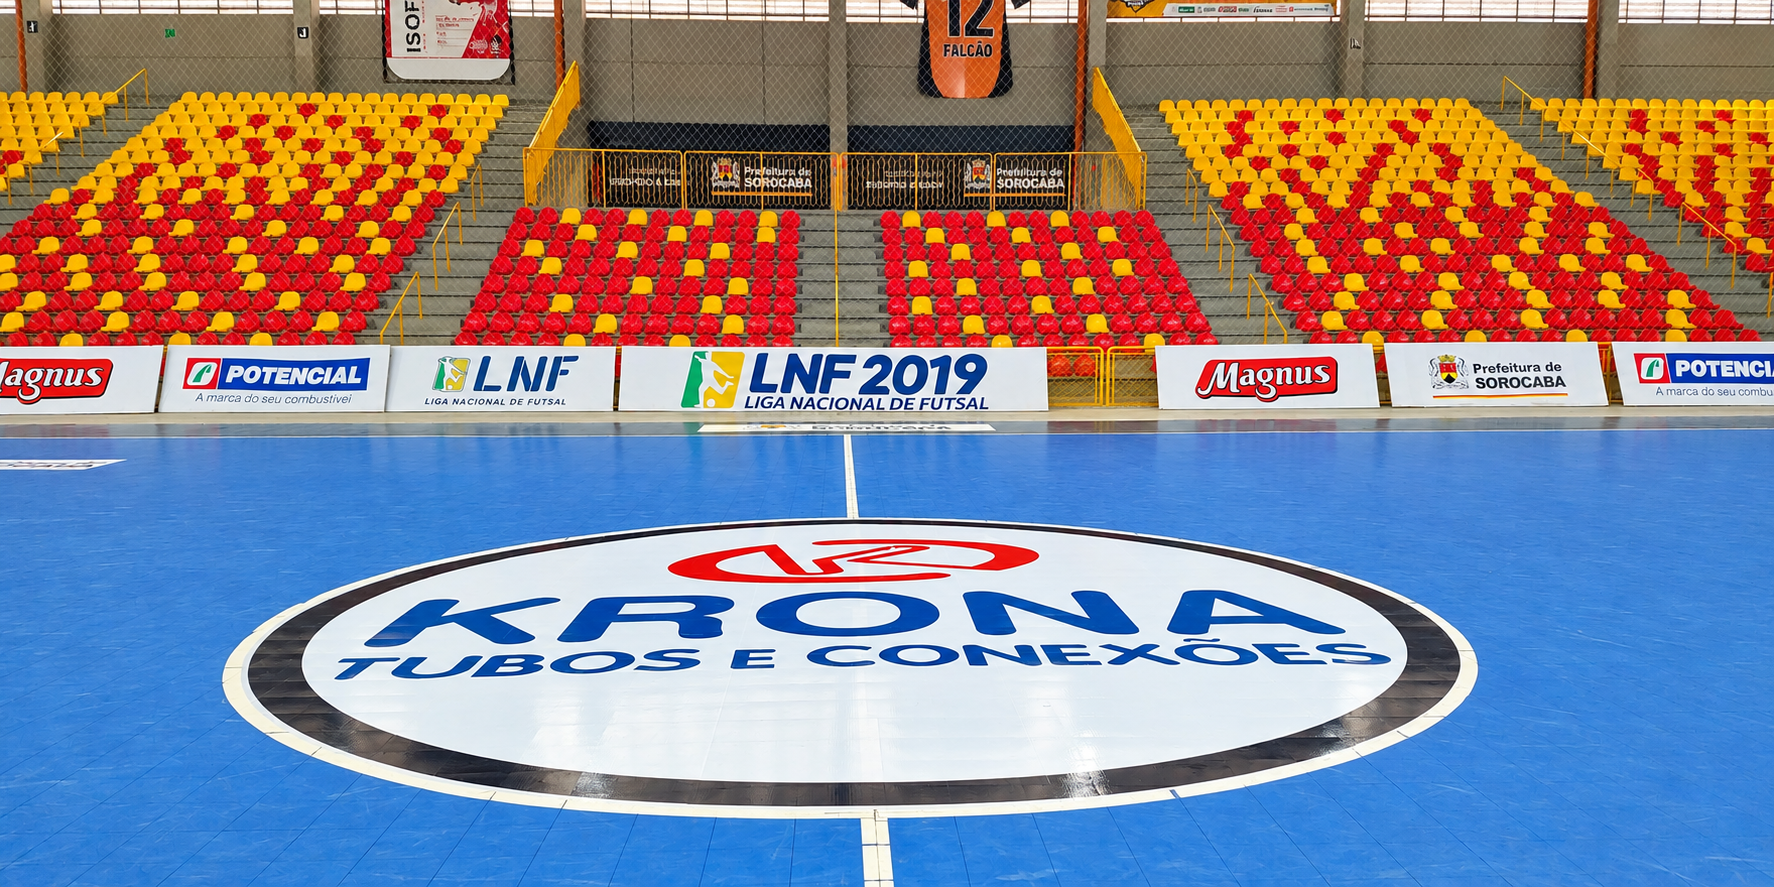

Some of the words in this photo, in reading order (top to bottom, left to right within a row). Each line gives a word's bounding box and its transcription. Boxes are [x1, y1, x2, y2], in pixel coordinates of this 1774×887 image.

[947, 0, 995, 39] 12
[943, 40, 994, 58] FALCÃO
[225, 365, 362, 385] POTENCIAL
[473, 355, 579, 392] LNF
[749, 352, 857, 395] LNF
[858, 353, 988, 396] 2019
[1473, 362, 1541, 374] Prefeitura
[1545, 361, 1562, 373] de
[1675, 359, 1774, 378] POTENCI
[1197, 361, 1331, 400] Magnus
[1475, 375, 1567, 390] SOROCABA
[195, 393, 204, 402] A
[206, 394, 242, 404] marca
[244, 393, 259, 404] do
[261, 395, 283, 404] seu
[1655, 386, 1664, 396] A
[1666, 388, 1699, 396] marca
[1701, 386, 1715, 396] do
[1717, 388, 1736, 397] seu
[424, 397, 449, 406] LIGA
[452, 397, 506, 406] NACIONAL
[509, 397, 524, 406] DE
[527, 397, 567, 406] FUTSAL
[744, 395, 786, 410] LIGA
[789, 395, 886, 411] NACIONAL
[889, 396, 915, 411] DE
[919, 396, 990, 411] FUTSAL
[364, 590, 1346, 648] KRONA
[335, 649, 701, 681] TUBOS
[731, 649, 776, 670] E
[807, 639, 1392, 668] CONEXÕES
